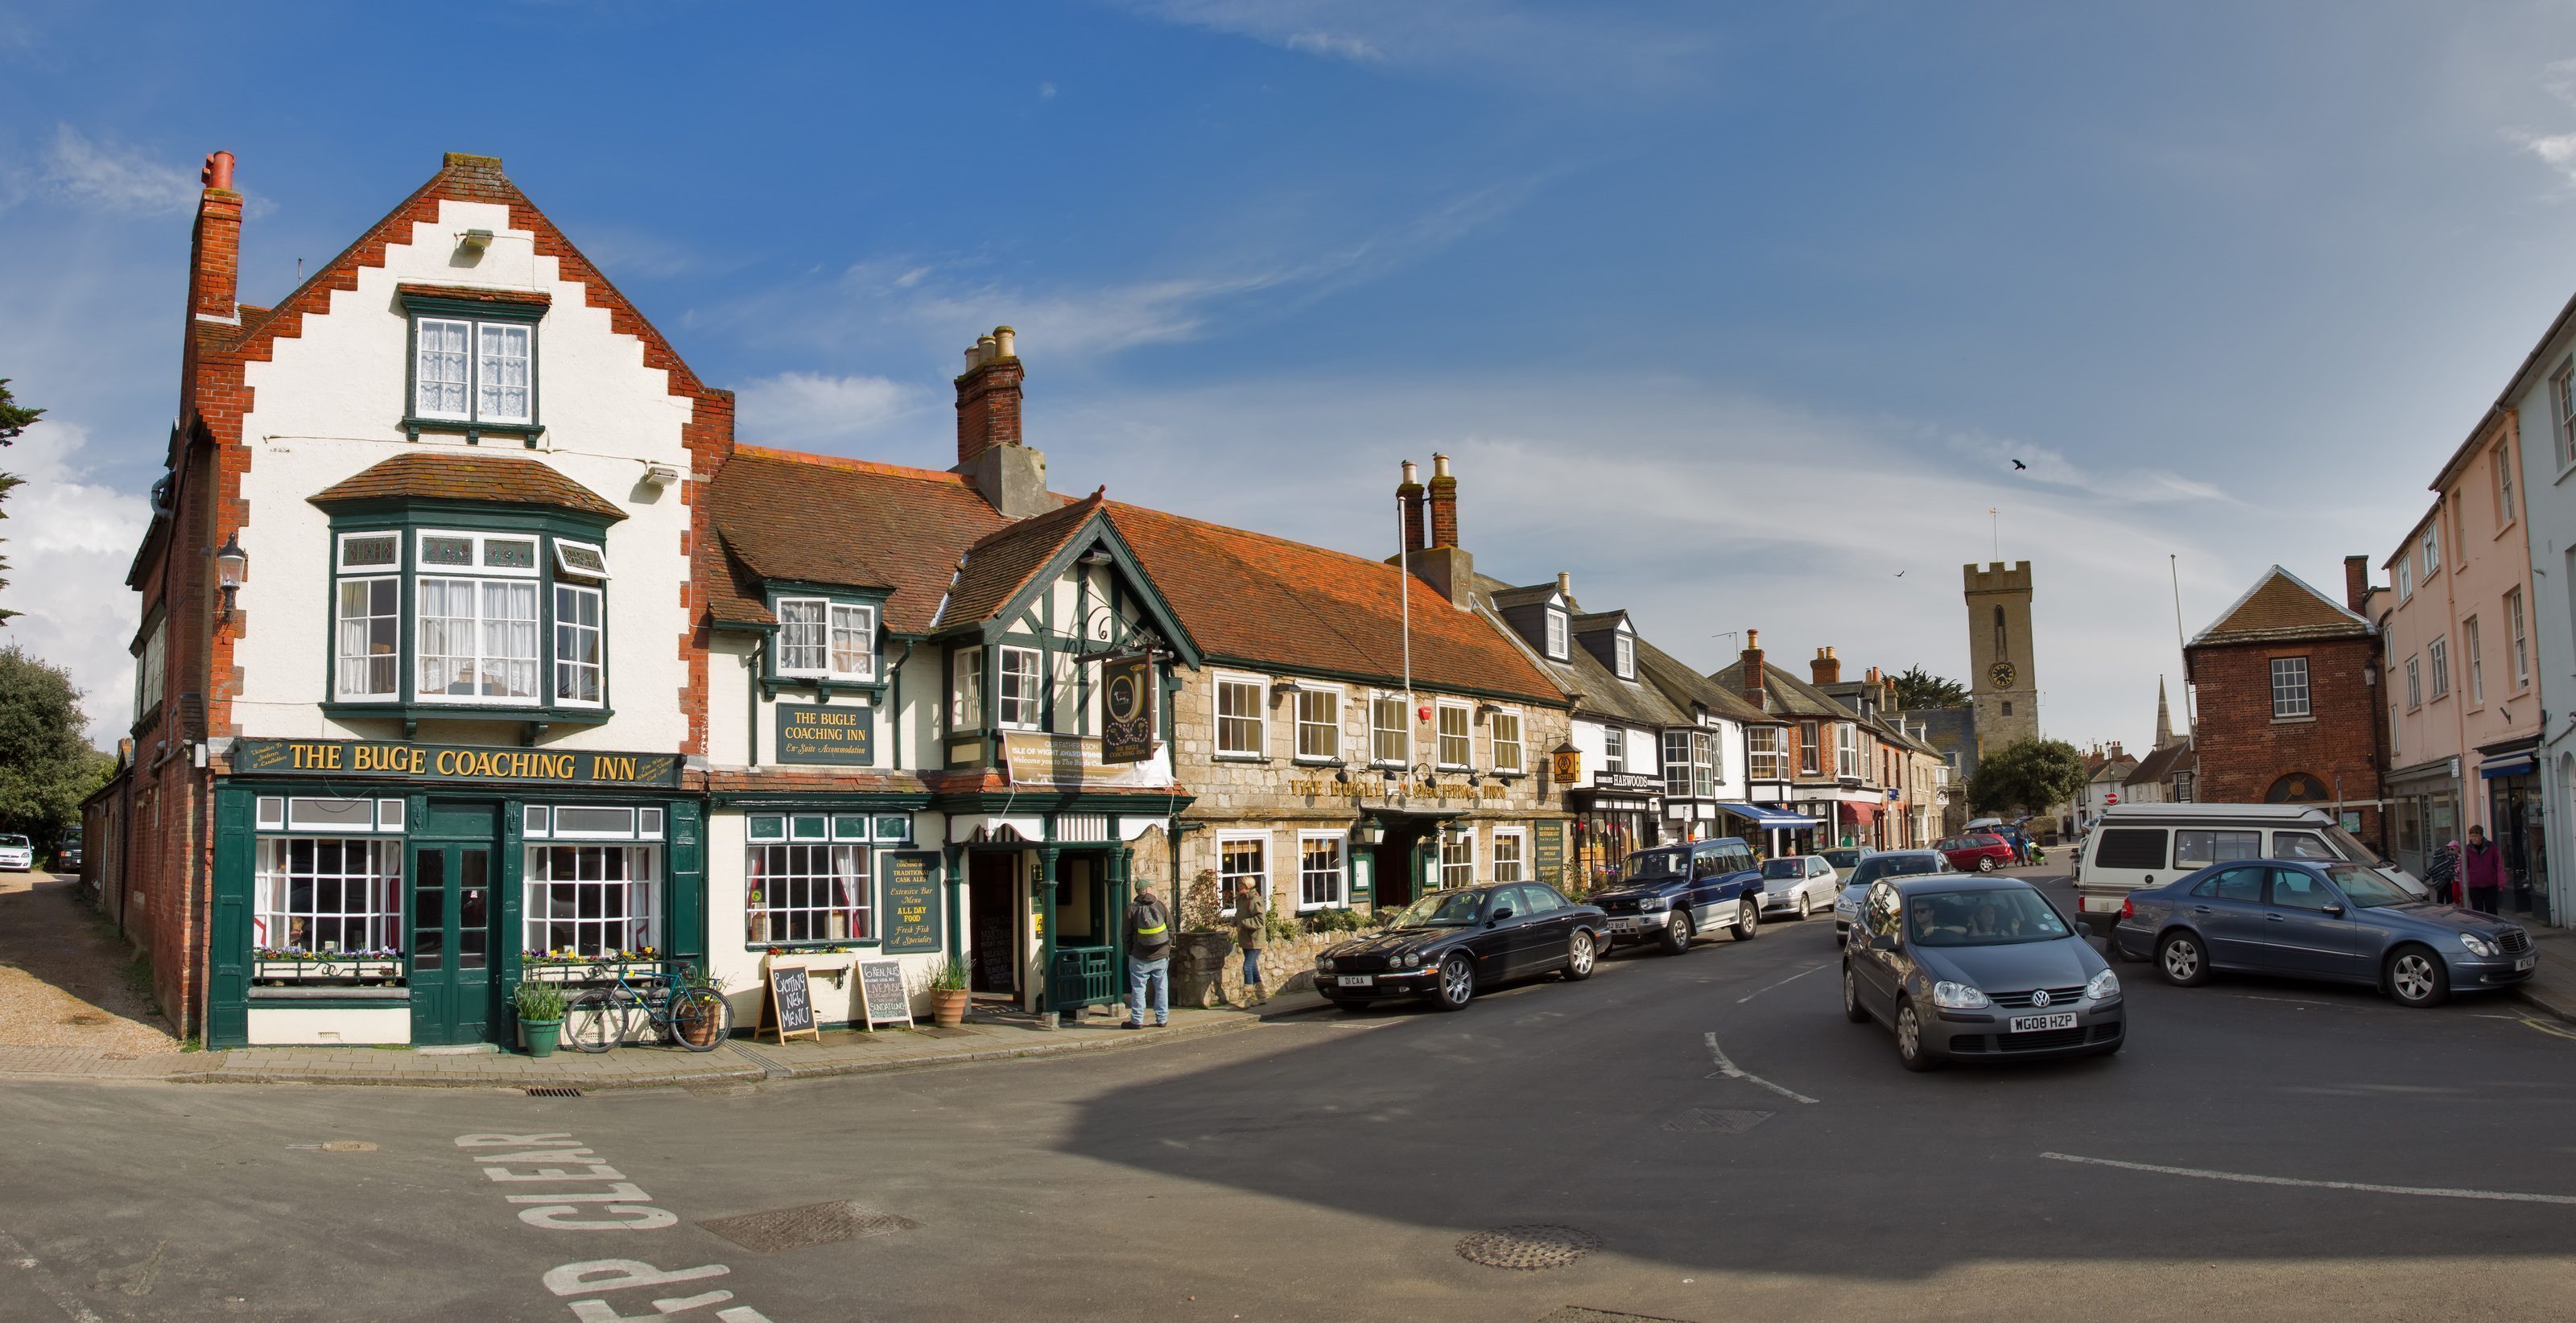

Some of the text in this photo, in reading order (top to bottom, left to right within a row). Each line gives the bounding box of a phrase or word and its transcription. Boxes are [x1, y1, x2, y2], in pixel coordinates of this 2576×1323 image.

[794, 711, 857, 725] THE BUGLE
[785, 727, 866, 740] COACHING INN
[818, 744, 866, 755] Accommodation
[1012, 747, 1026, 755] ISLE
[1037, 748, 1059, 756] WIGHT
[289, 744, 638, 781] THE BUGE COACHING INN
[1012, 756, 1040, 765] Welcome
[1062, 758, 1073, 766] The
[1074, 759, 1092, 767] Bugle
[1613, 774, 1648, 787] HARWOODS
[1288, 779, 1507, 799] THE BUGLE COACHING INN
[921, 887, 933, 895] Bar
[914, 906, 927, 914] DAY
[904, 914, 921, 922] FOOD
[894, 925, 930, 935] Fresh Fish
[891, 935, 932, 946] A Speciality
[864, 966, 901, 978] 6 REAL ALES
[1352, 977, 1364, 985] CAA
[866, 982, 903, 994] LIVE MUSIC
[786, 989, 805, 1009] NEW
[869, 1001, 907, 1012] SUNDAY LUNCH
[782, 1006, 809, 1028] MENU
[2015, 1014, 2072, 1031] WG08 HZP
[454, 1132, 679, 1230] CLEAR
